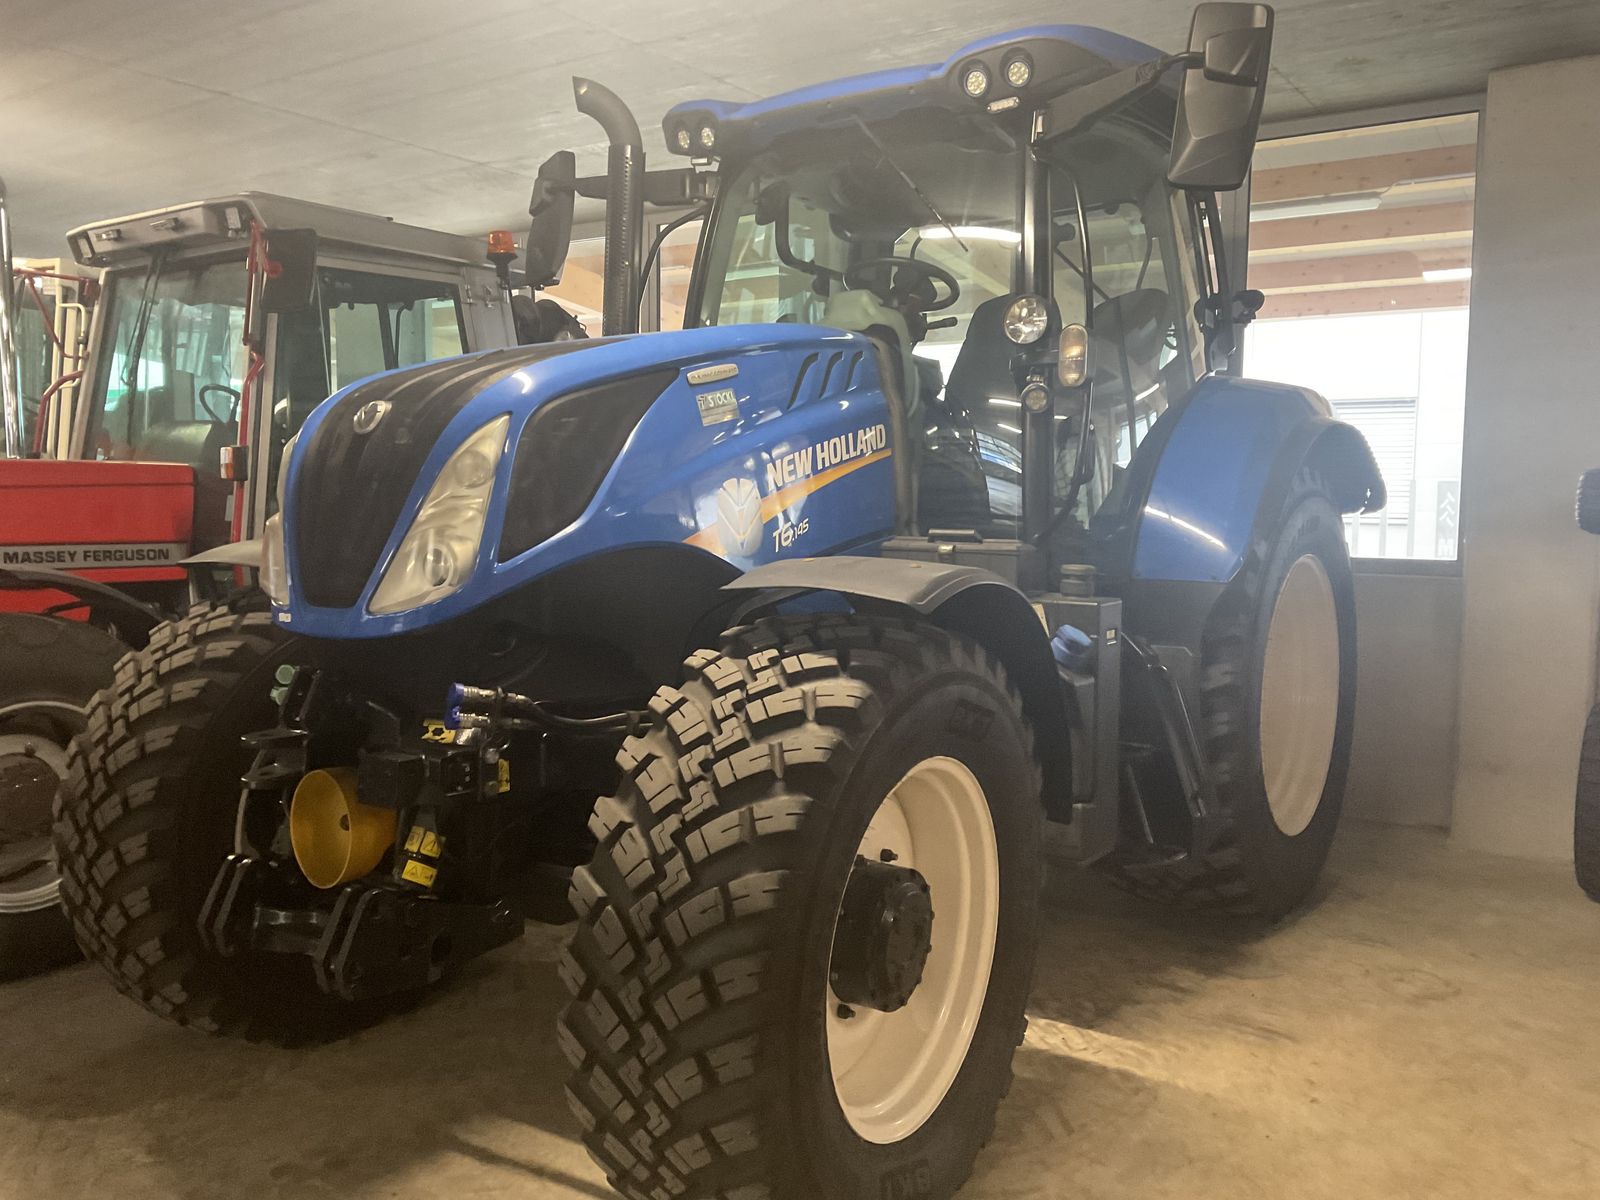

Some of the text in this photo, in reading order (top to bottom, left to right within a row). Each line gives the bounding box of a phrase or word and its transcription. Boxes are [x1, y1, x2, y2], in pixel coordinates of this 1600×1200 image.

[766, 423, 887, 492] NEW HOLLAND
[772, 517, 809, 553] T6.145
[3, 548, 170, 564] MASSEY FERGUSON
